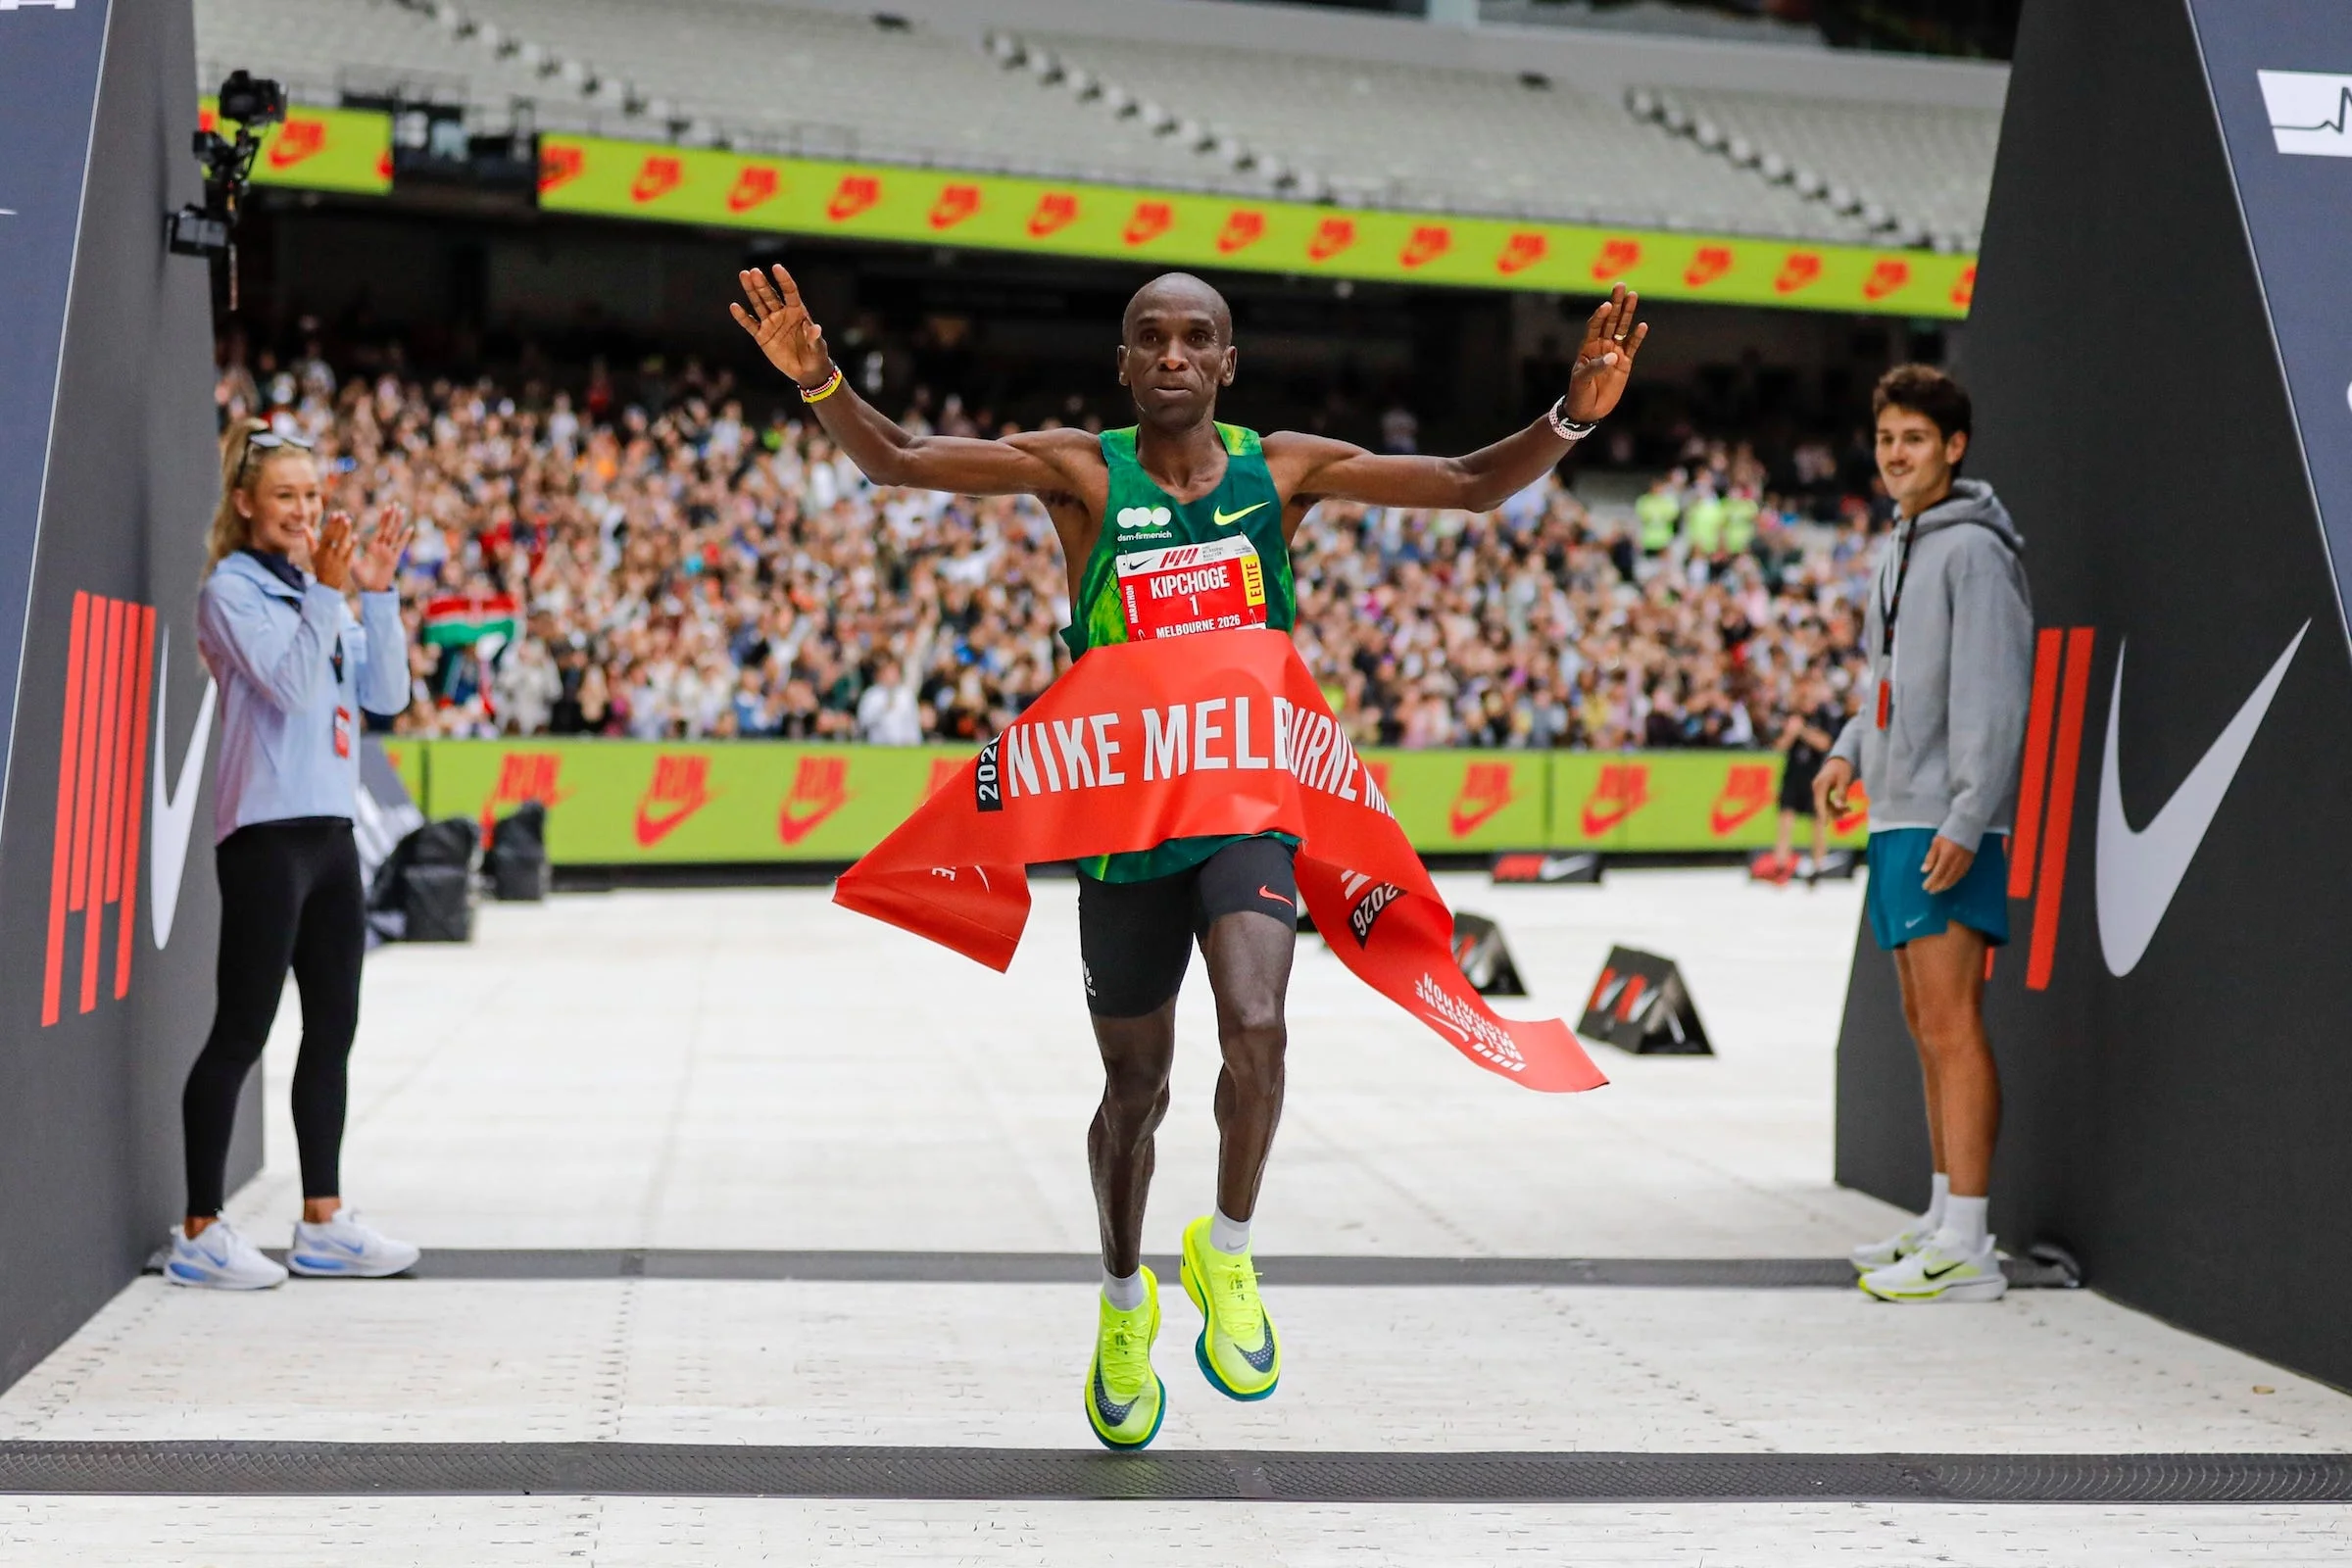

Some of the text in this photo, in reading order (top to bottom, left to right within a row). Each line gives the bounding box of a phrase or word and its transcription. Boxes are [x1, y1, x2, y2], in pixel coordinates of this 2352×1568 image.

[1117, 530, 1173, 542] dsm-firmenich
[1150, 565, 1231, 600] KIPCHOGE
[1246, 562, 1262, 598] ELITE
[1125, 584, 1140, 624] MARATHON
[1189, 594, 1200, 616] 1
[1155, 613, 1241, 639] MELBOURNE 2026
[1006, 712, 1125, 798] NIKE
[1353, 882, 1399, 937] 2026
